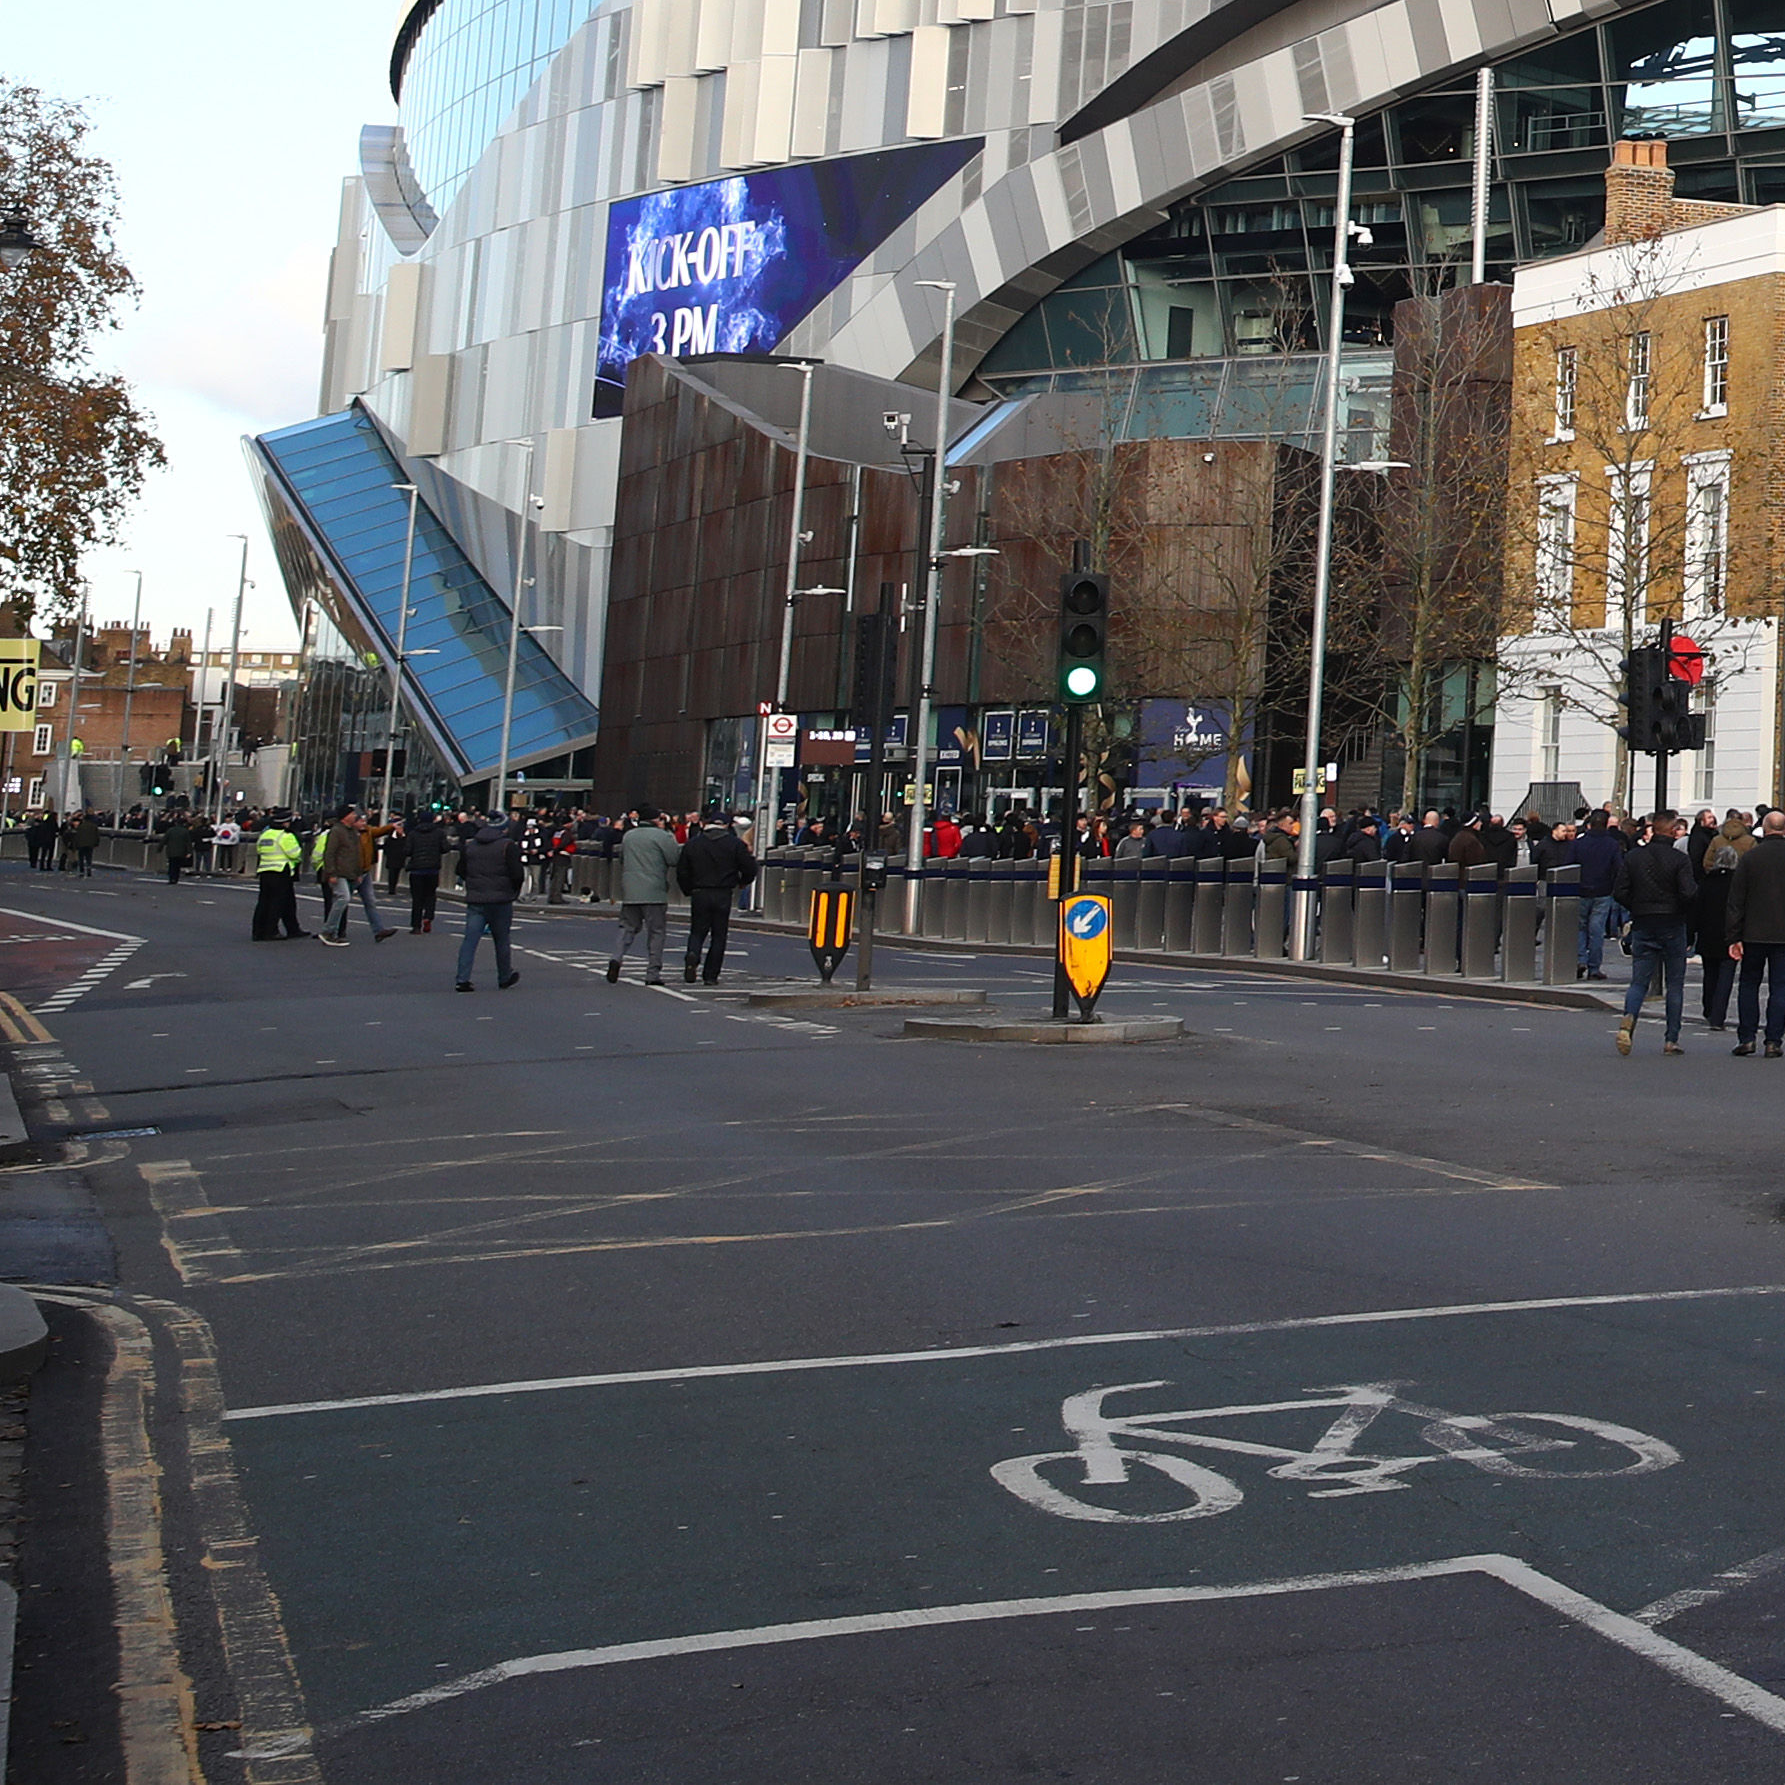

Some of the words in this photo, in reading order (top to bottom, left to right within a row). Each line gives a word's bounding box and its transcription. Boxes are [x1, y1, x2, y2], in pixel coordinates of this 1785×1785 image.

[628, 220, 756, 296] KICK-OFF
[651, 312, 668, 355] 3
[672, 303, 719, 357] PM
[760, 703, 773, 714] N
